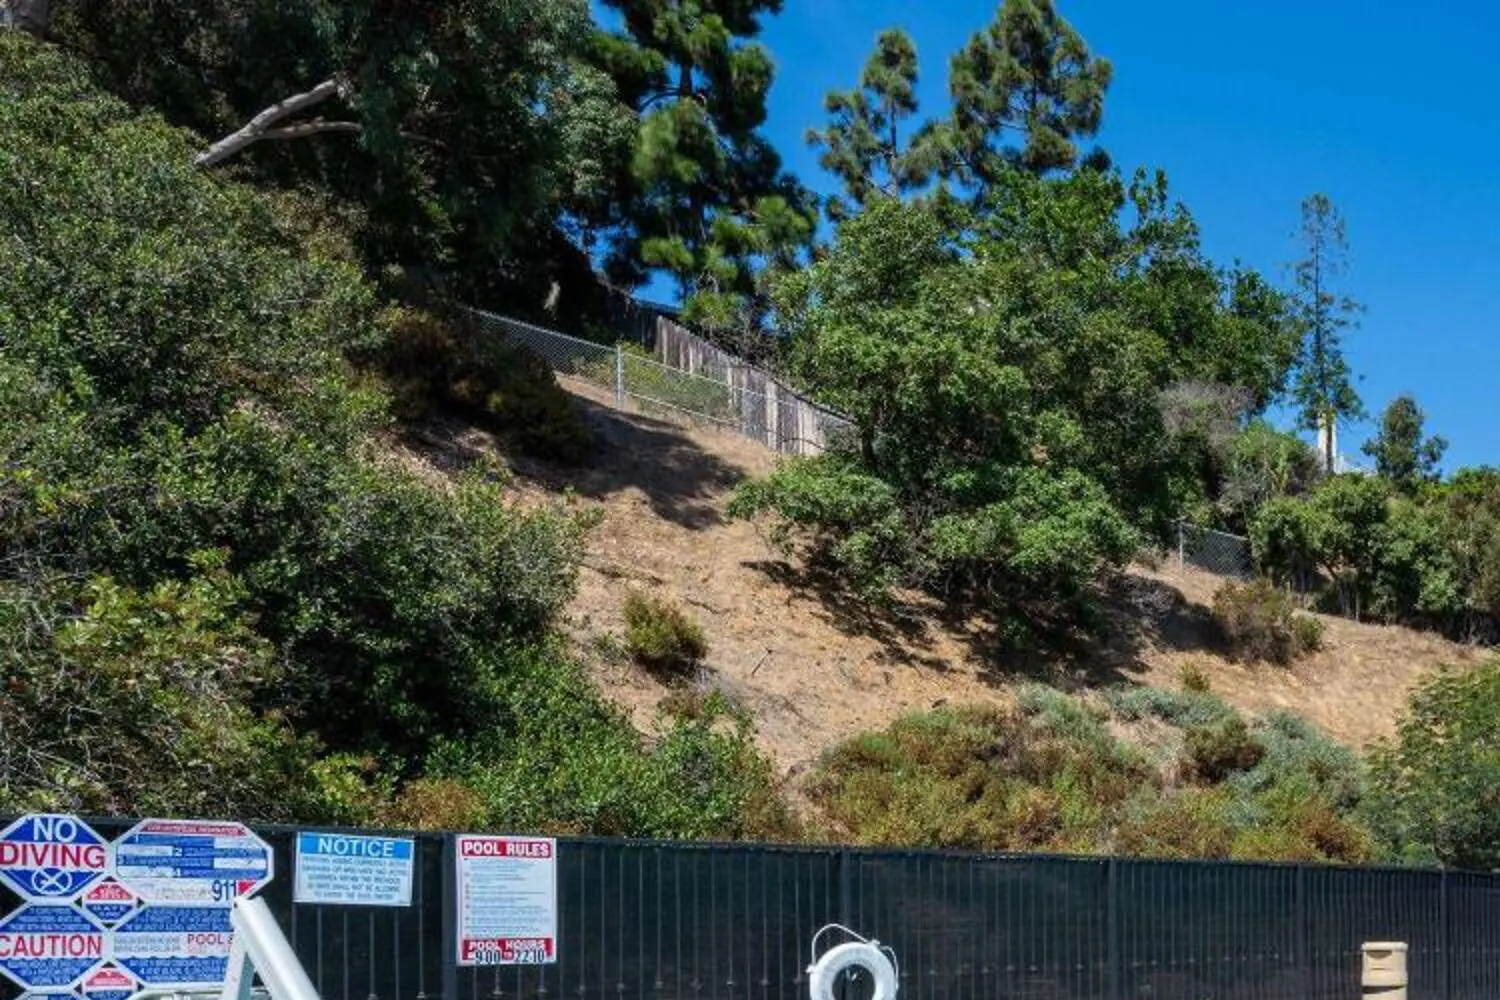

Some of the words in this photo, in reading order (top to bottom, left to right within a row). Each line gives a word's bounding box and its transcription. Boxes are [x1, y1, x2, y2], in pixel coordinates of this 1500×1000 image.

[33, 817, 77, 842] NO
[0, 843, 105, 868] DIVING
[319, 837, 395, 857] NOTICE
[463, 841, 502, 856] POOL
[506, 842, 550, 857] RULES
[211, 880, 236, 901] 911
[0, 934, 101, 957] CAUTION
[187, 933, 224, 945] POOL
[469, 940, 501, 951] POOL
